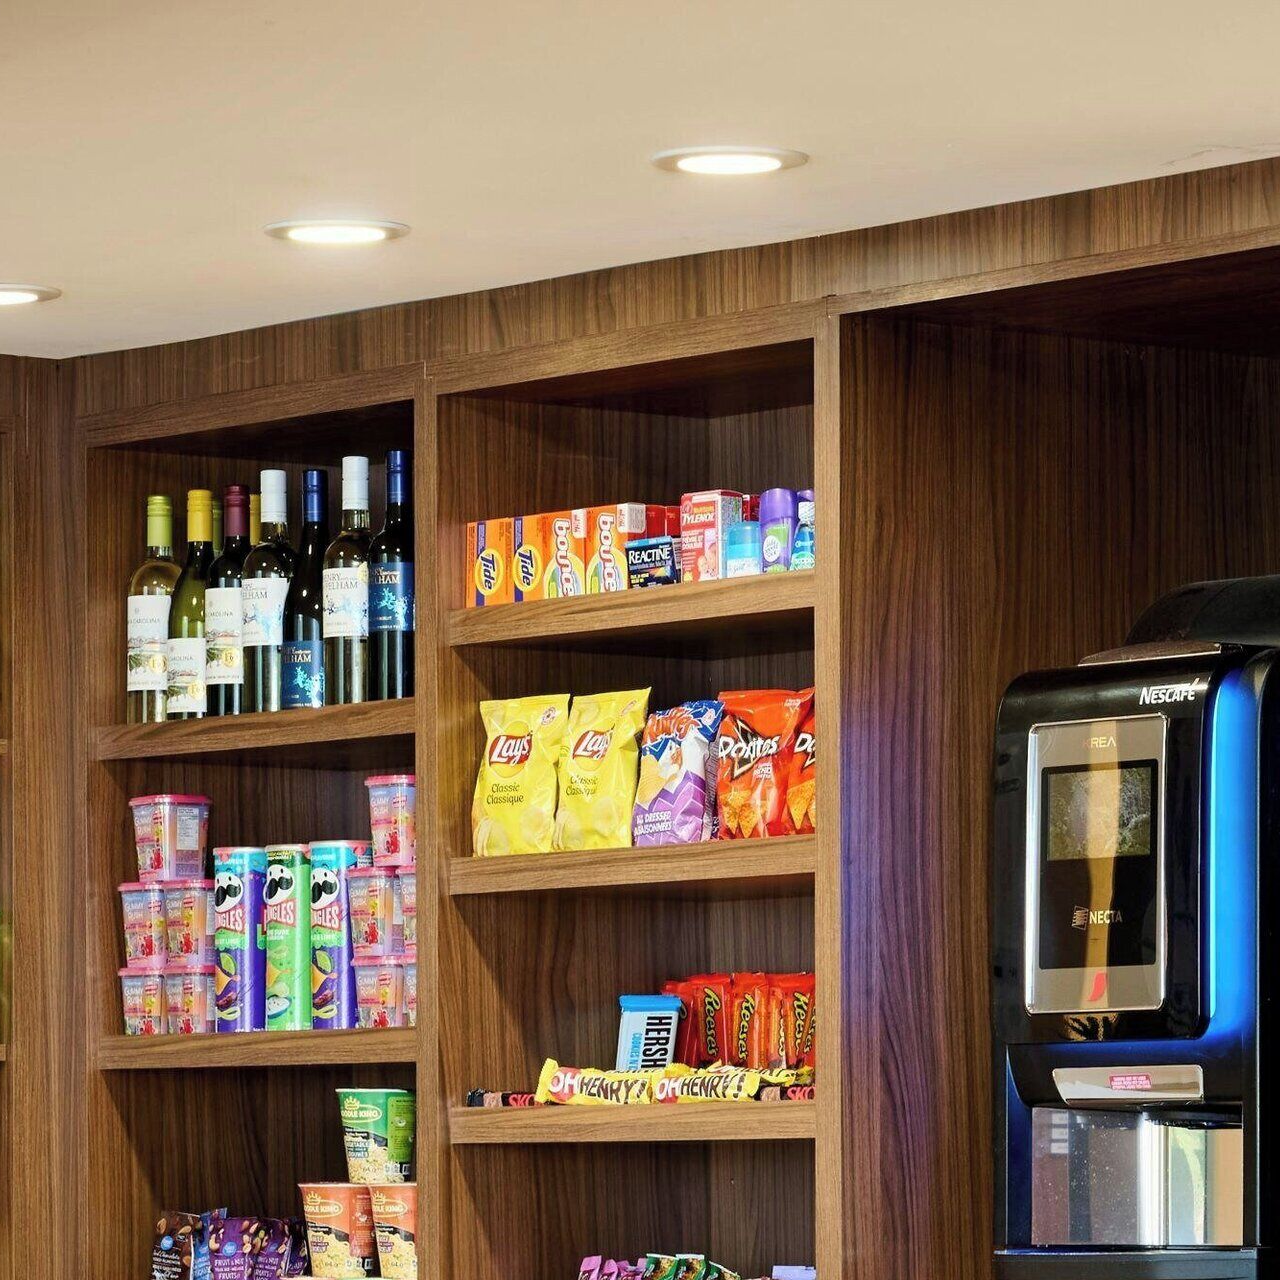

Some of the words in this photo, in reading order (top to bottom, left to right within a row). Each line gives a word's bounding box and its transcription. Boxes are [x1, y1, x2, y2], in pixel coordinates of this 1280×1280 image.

[682, 513, 715, 524] TYLENOL
[554, 519, 574, 596] bounce
[600, 514, 616, 592] bounce
[628, 548, 670, 565] REACTINE
[481, 554, 495, 590] Tide
[518, 550, 533, 586] Tide
[1140, 678, 1200, 705] NESCAFÉ
[719, 735, 778, 762] Doritos
[486, 794, 524, 805] Classique
[491, 783, 520, 794] Classic
[1089, 910, 1123, 924] NECTA
[704, 986, 720, 1056] Reese's
[738, 993, 755, 1059] Reese's
[549, 1072, 579, 1093] OH
[654, 1079, 680, 1099] OH
